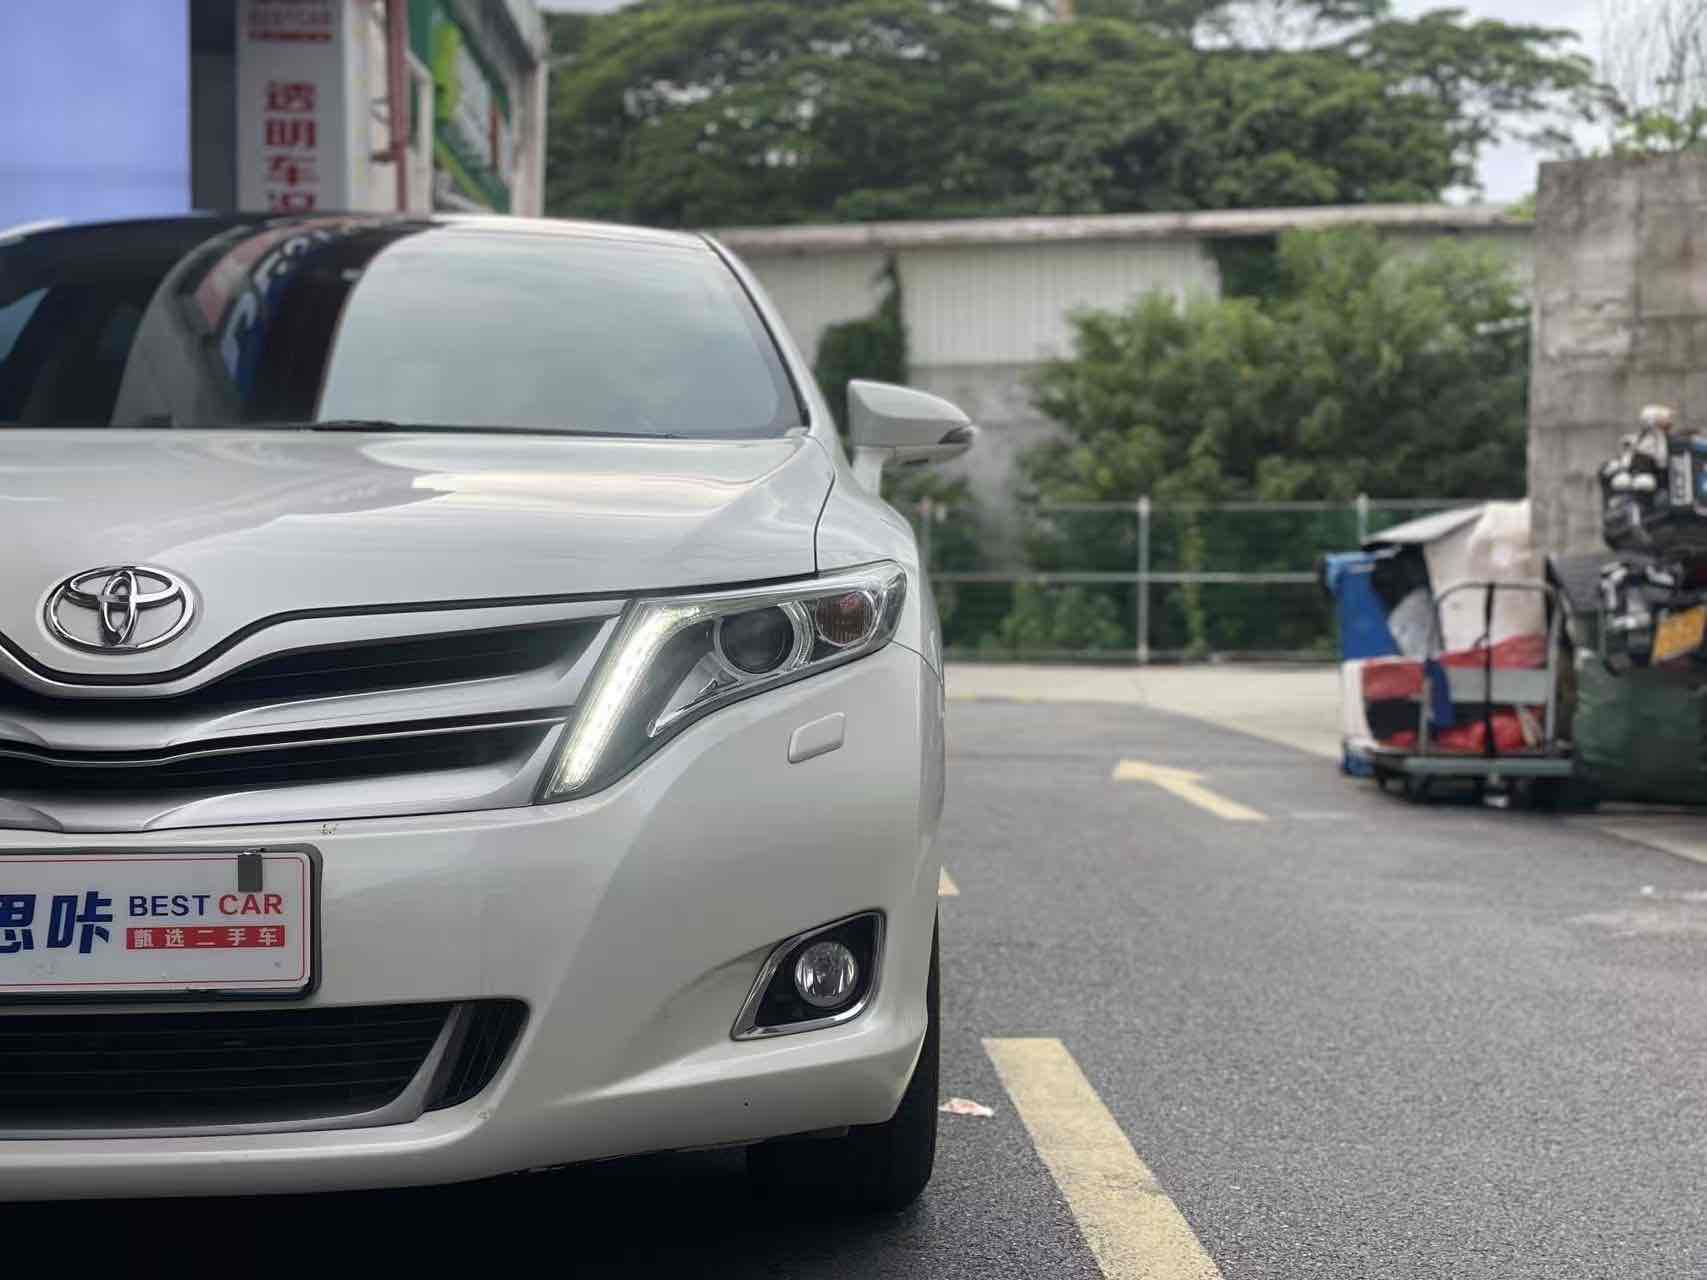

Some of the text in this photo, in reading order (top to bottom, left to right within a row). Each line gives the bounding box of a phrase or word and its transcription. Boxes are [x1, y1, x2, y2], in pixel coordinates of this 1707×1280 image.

[129, 893, 283, 916] BEST CAR
[134, 928, 278, 949] 甄选二手车
